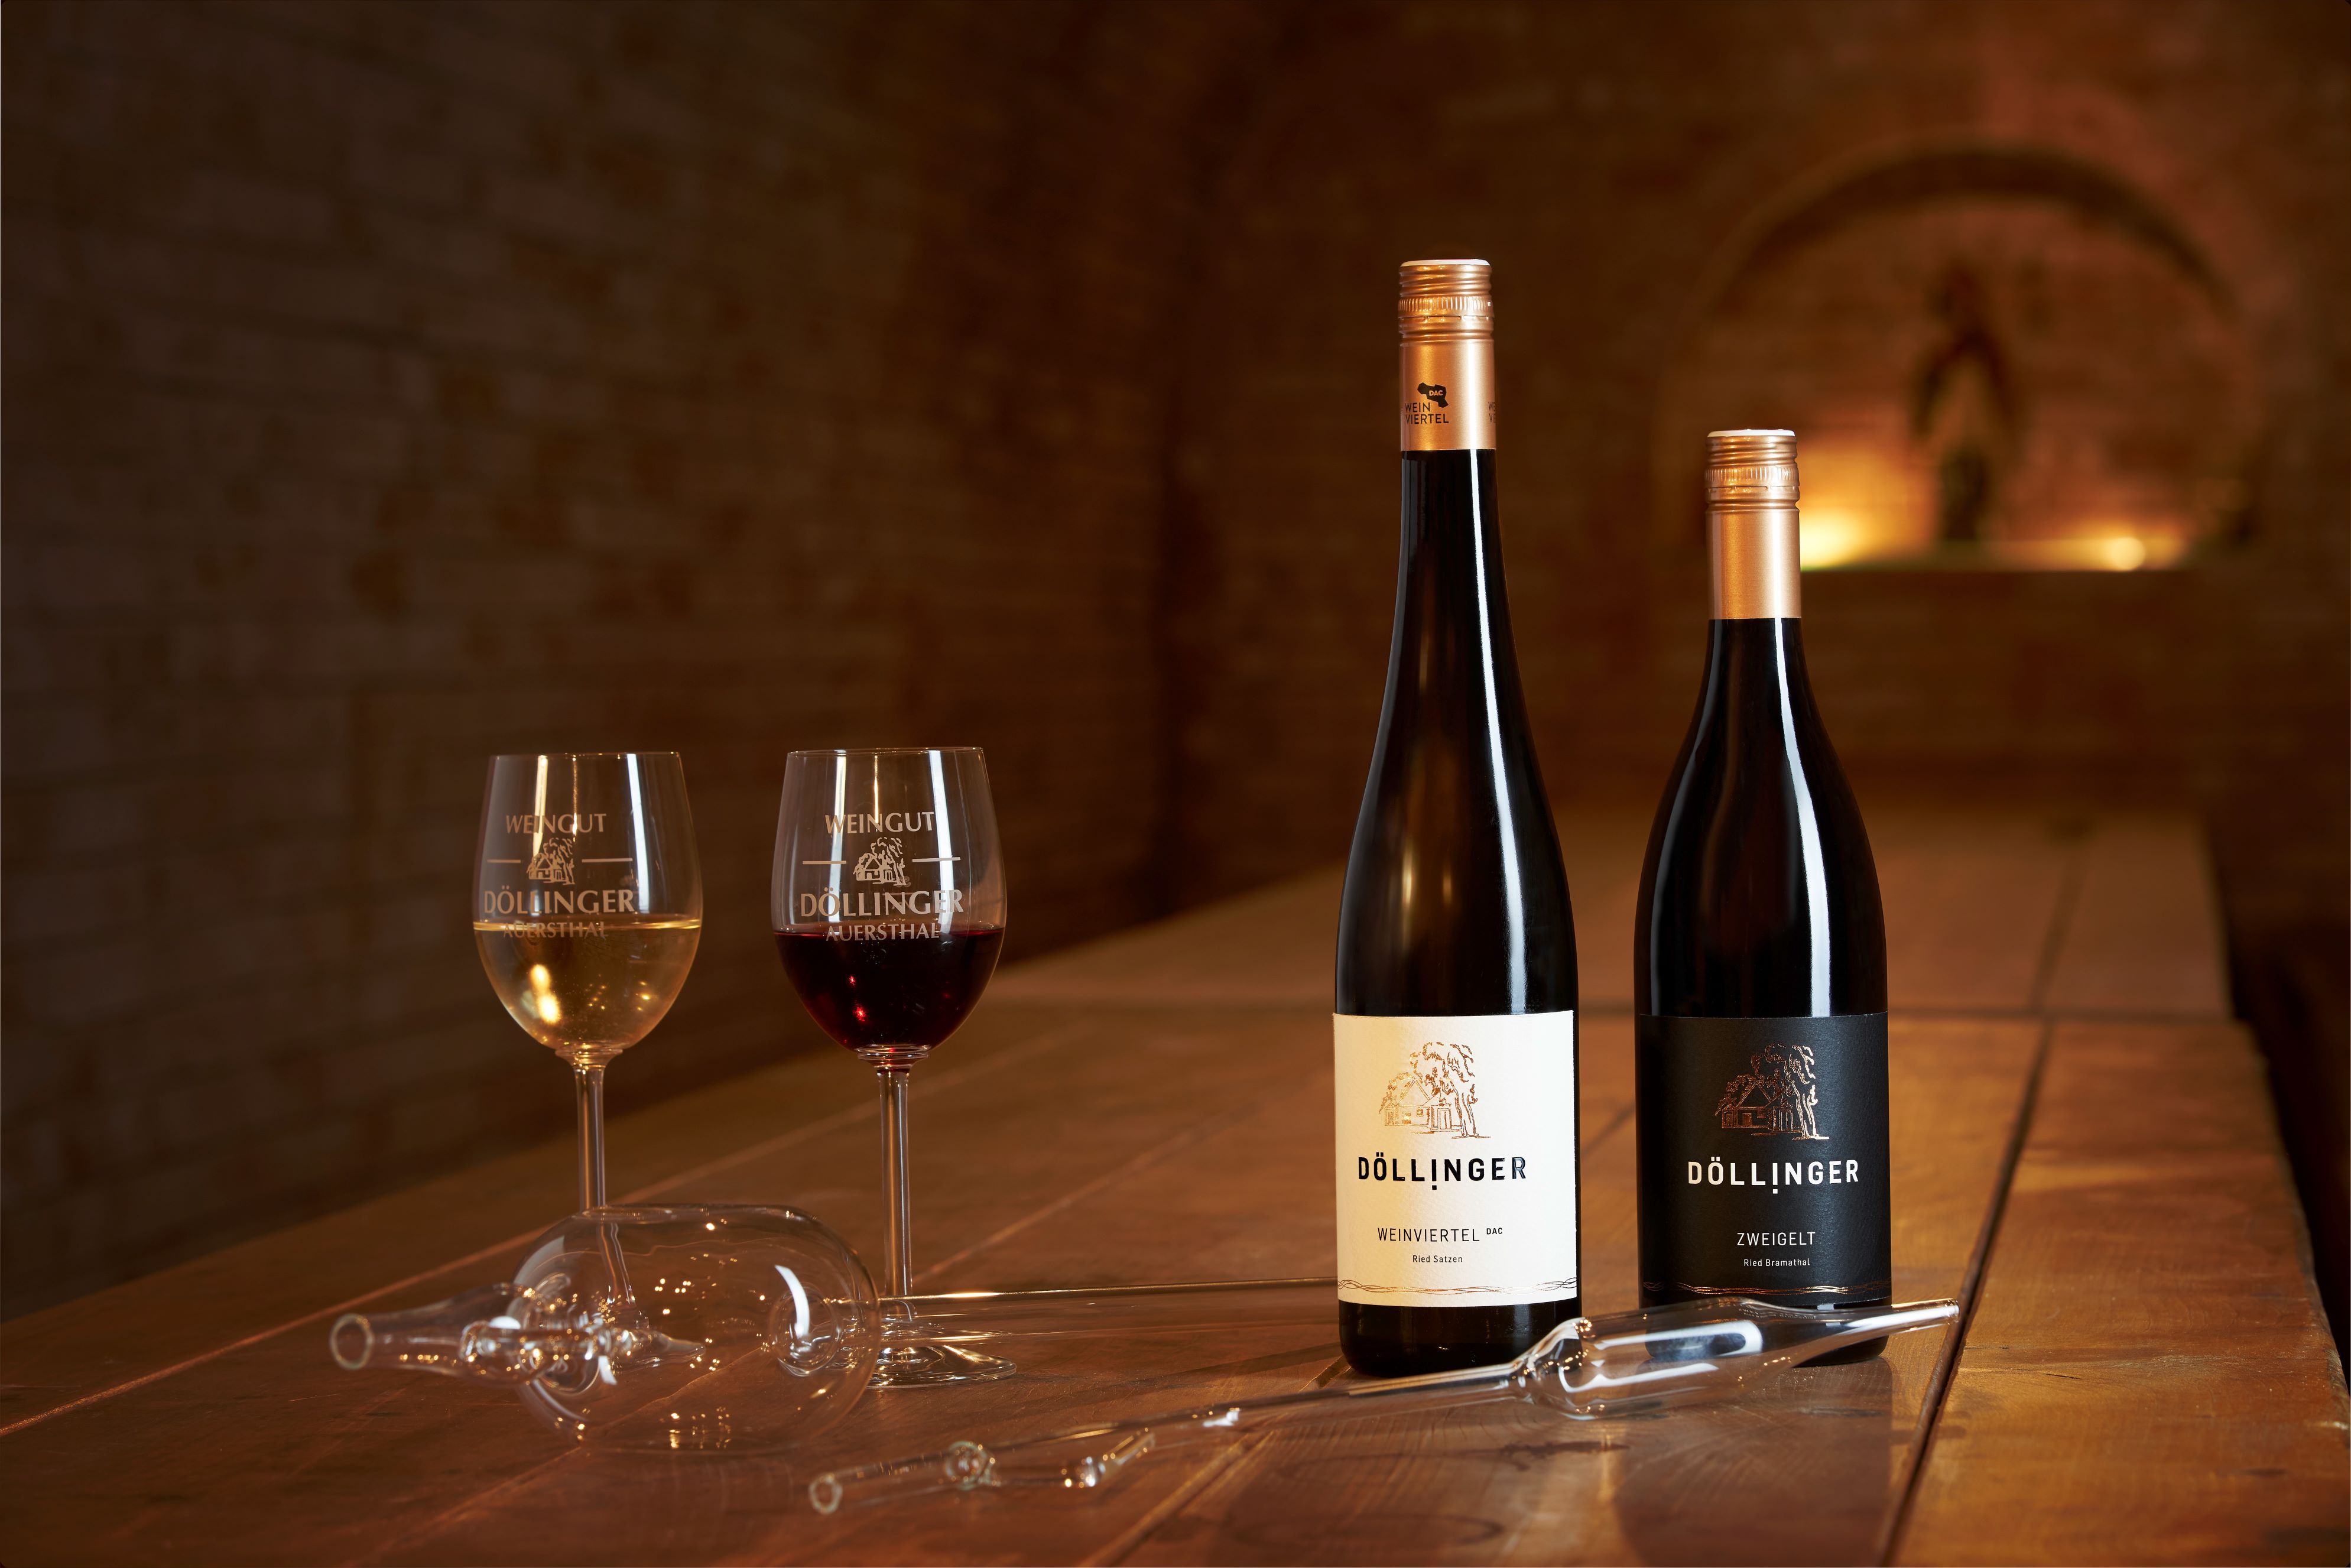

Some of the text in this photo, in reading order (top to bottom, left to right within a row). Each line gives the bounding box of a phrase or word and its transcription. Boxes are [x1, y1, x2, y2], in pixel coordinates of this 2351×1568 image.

[1405, 402, 1431, 413] WEIN
[1405, 413, 1449, 424] VIERTEL
[506, 813, 607, 834] WEINGUT
[825, 811, 934, 834] WEINGUT
[484, 885, 635, 914] DÖLLINGER
[801, 887, 964, 917] DÖLLINGER
[503, 921, 609, 939] AUERSTHAL
[826, 923, 940, 942] AUERSTHAL
[1378, 1227, 1503, 1242] WEINVIERTEL DAC
[1737, 1232, 1816, 1246] ZWEIGELT
[1412, 1255, 1463, 1263] Ried Satzen
[1766, 1258, 1810, 1267] Bramathal
